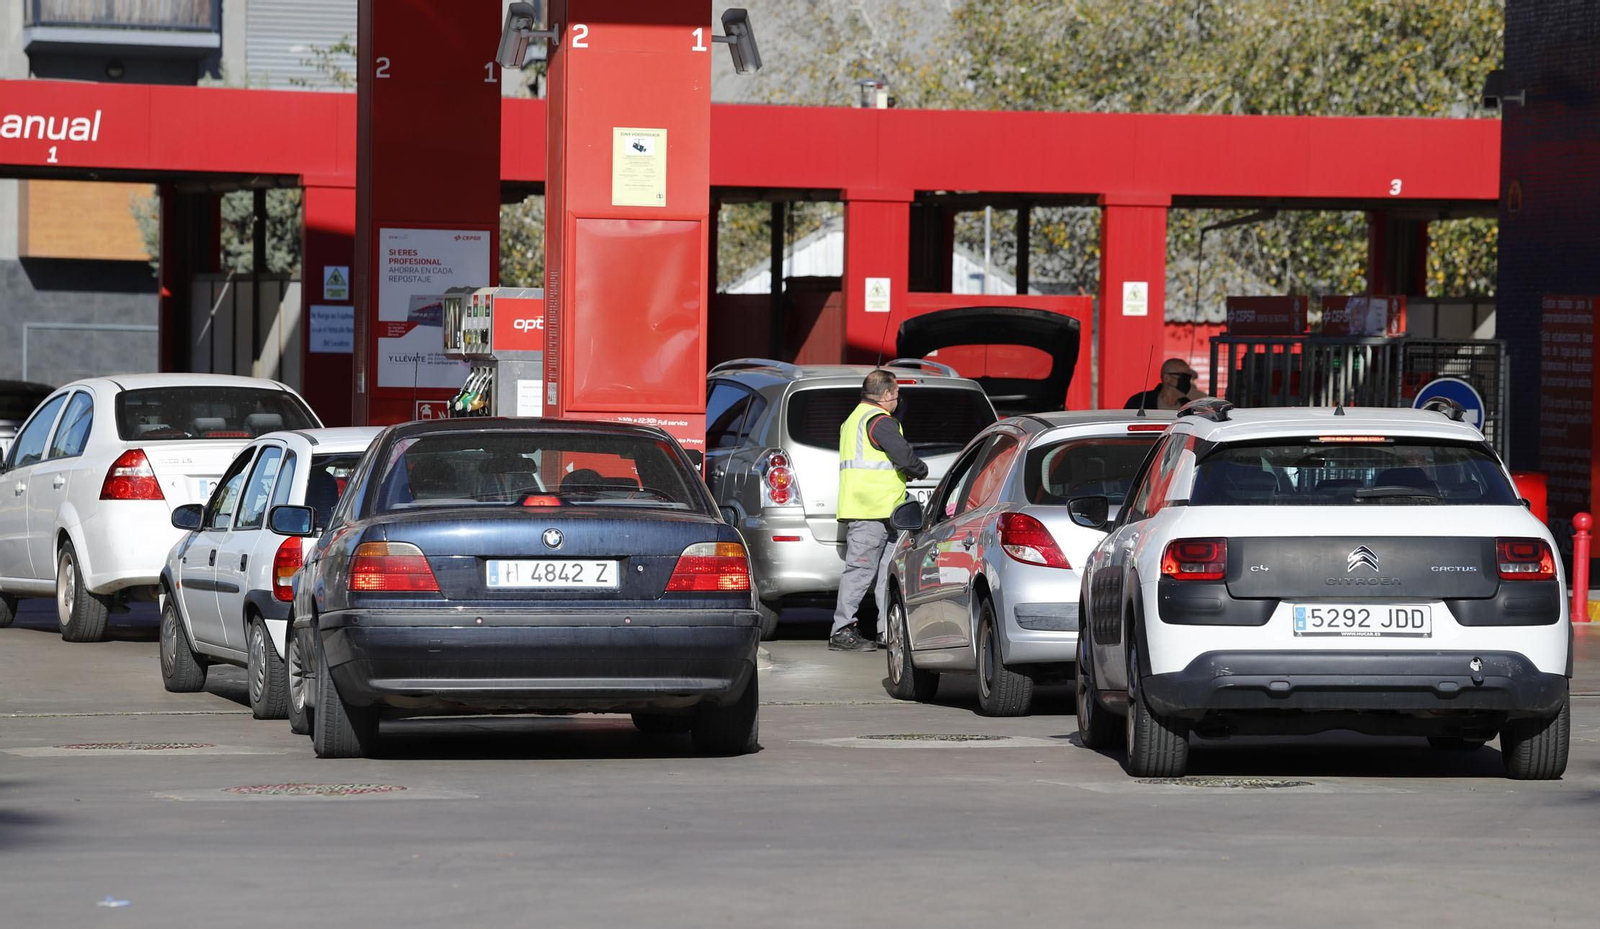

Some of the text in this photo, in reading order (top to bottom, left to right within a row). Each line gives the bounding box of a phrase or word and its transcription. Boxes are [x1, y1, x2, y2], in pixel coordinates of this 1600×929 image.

[571, 23, 589, 48] 2
[691, 28, 707, 52] 1
[375, 57, 391, 79] 2
[484, 62, 498, 83] 1
[0, 109, 102, 142] anual
[46, 146, 58, 163] 1
[1389, 178, 1402, 195] 3
[388, 248, 418, 257] SI ERES
[388, 257, 442, 266] PROFESIONAL
[388, 266, 454, 275] AHORRA EN CADA
[388, 275, 432, 283] REPOSTAJE
[513, 318, 544, 333] opt
[394, 354, 426, 363] LLÉVATE
[209, 481, 218, 496] 2
[530, 563, 584, 583] 4842
[595, 563, 608, 583] Z
[1250, 564, 1269, 572] C4
[1311, 608, 1371, 628] 5292
[1381, 608, 1424, 629] JDD
